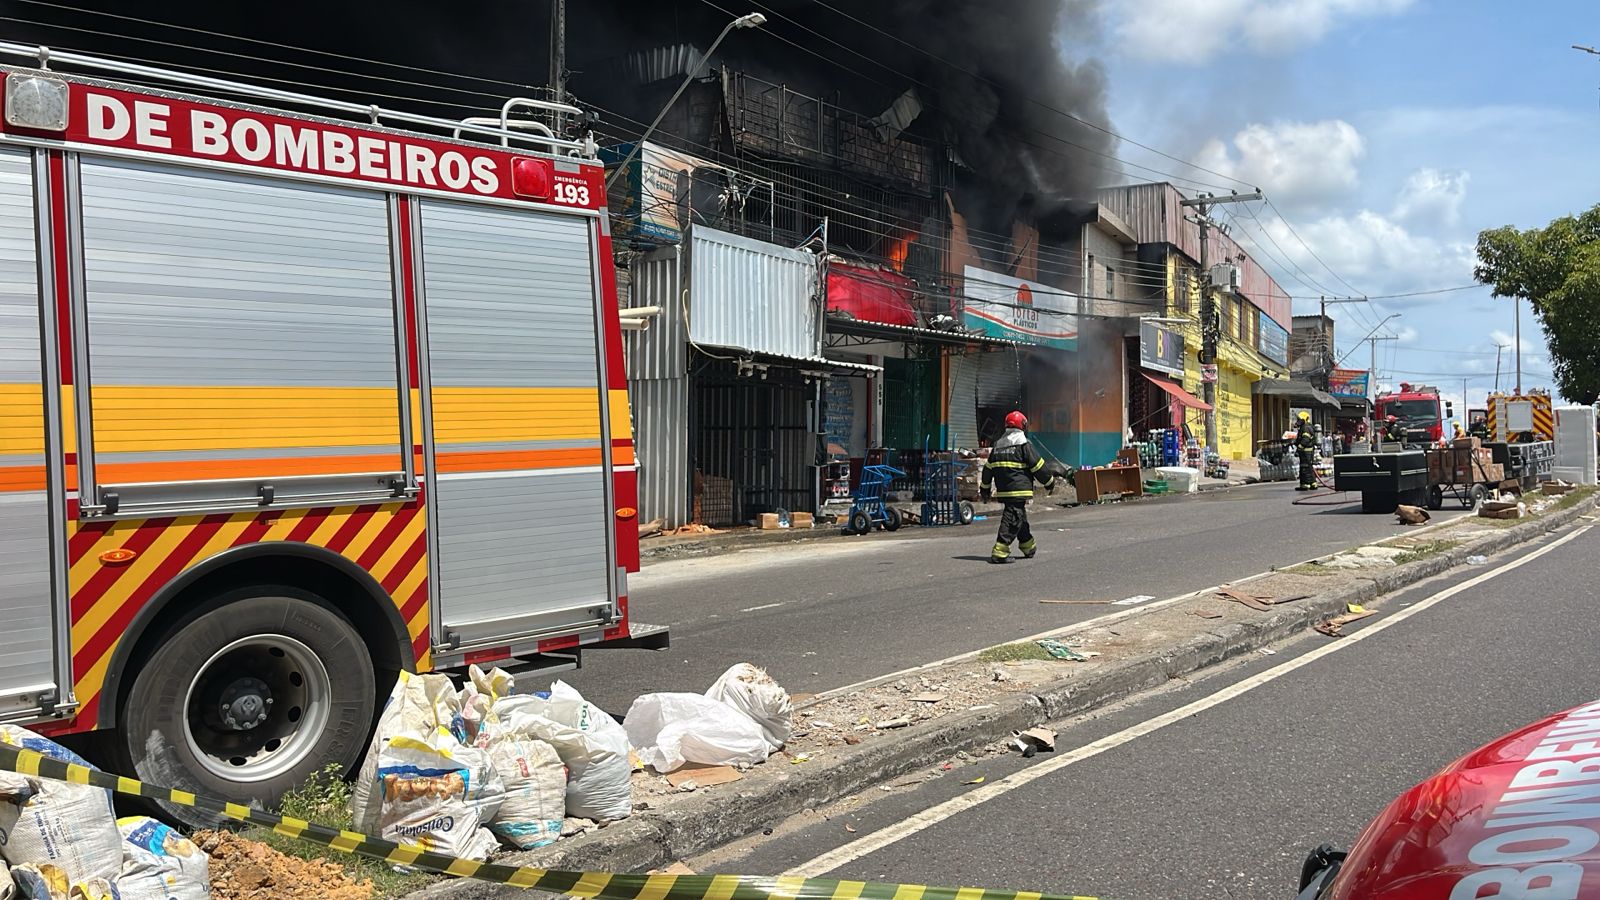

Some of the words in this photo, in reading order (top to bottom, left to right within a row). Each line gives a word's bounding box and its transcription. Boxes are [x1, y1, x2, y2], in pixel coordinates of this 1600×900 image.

[86, 93, 171, 149] DE
[190, 109, 499, 194] BOMBEIROS
[553, 175, 588, 186] EMERGÊNCIA
[553, 183, 590, 206] 193
[395, 815, 454, 838] Consolata
